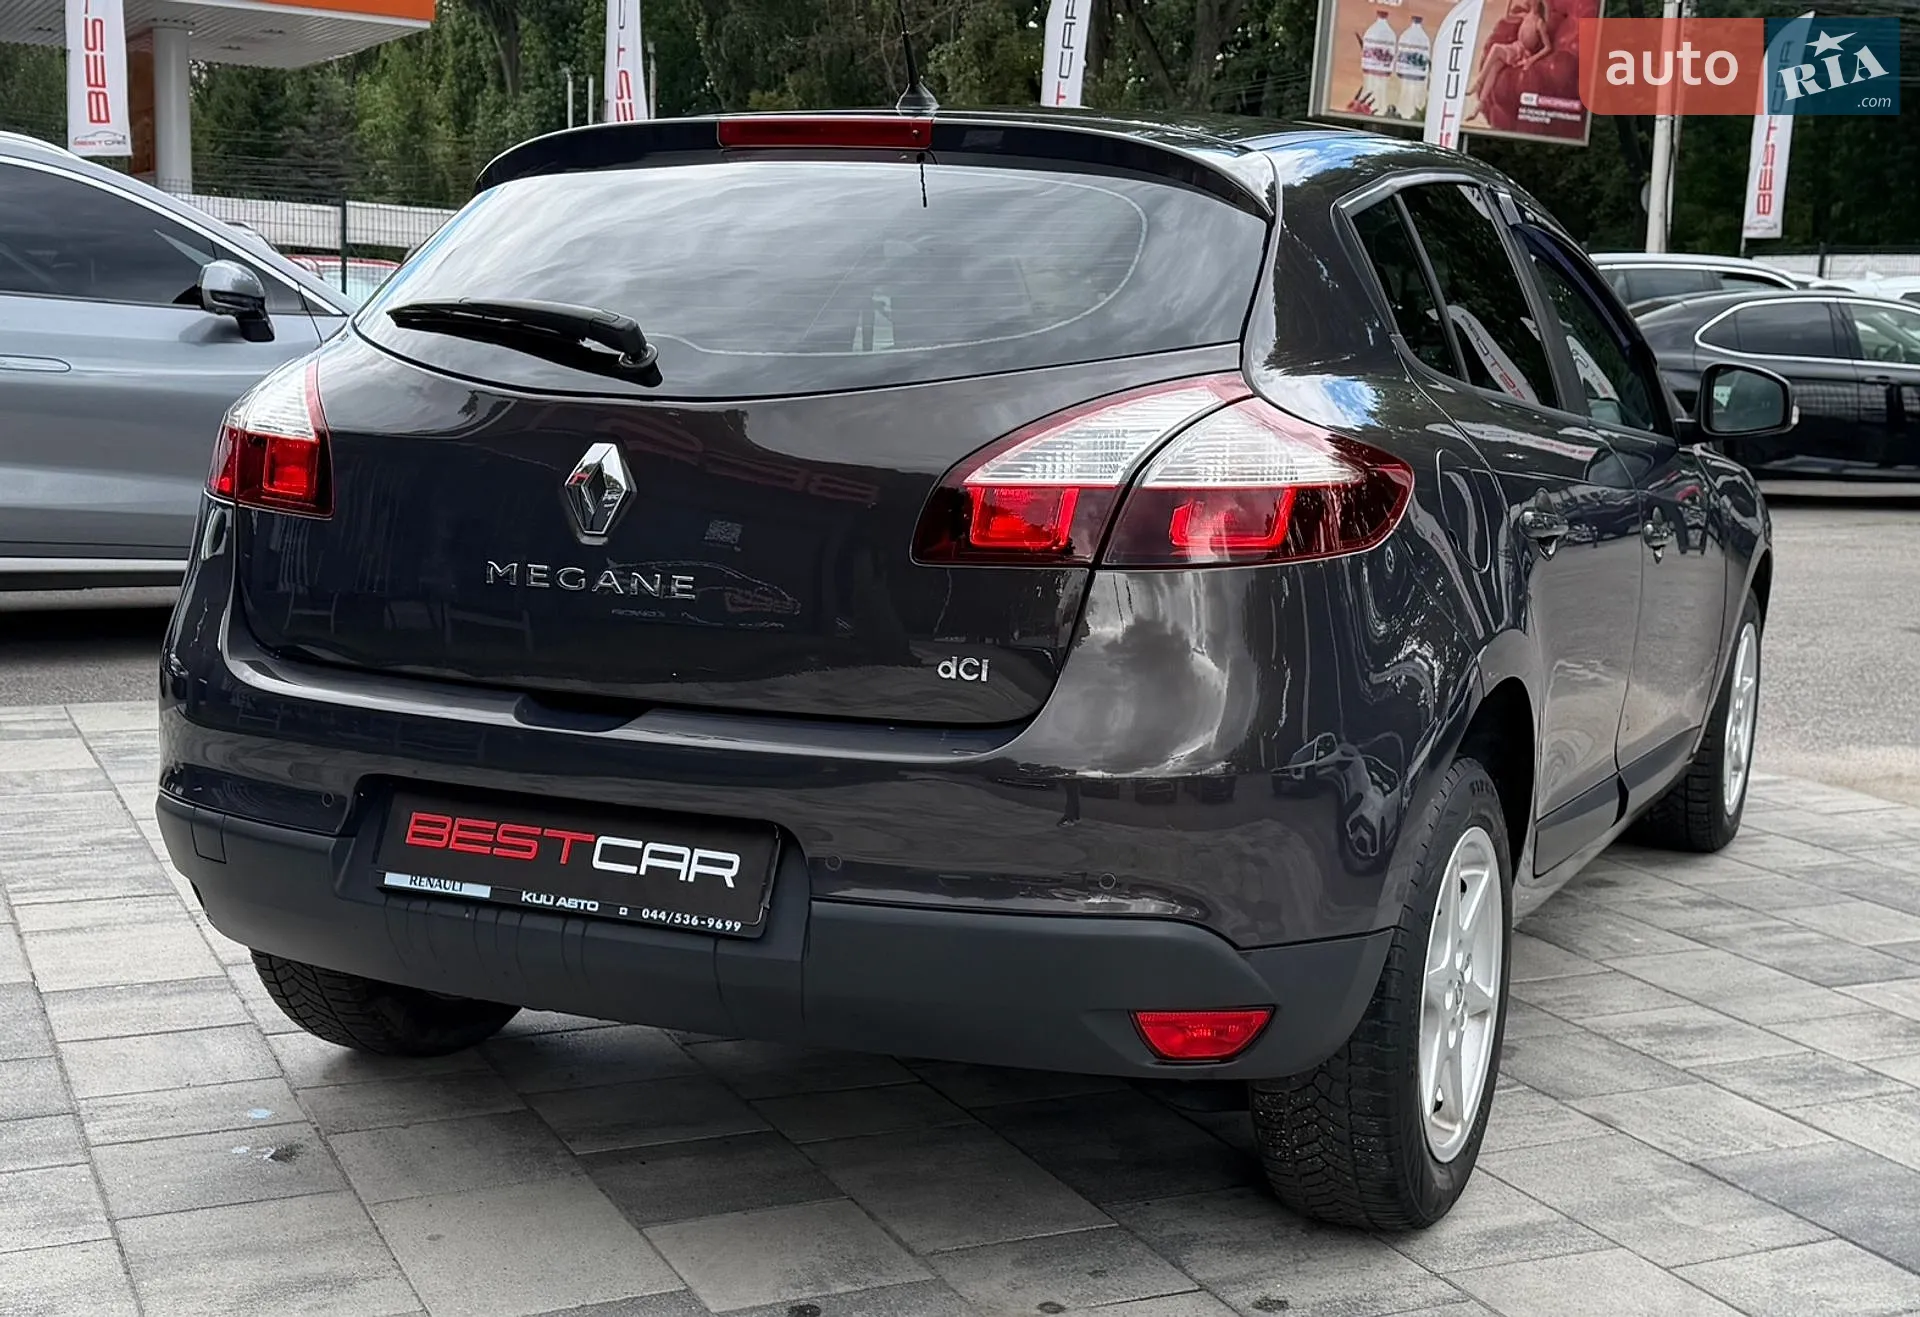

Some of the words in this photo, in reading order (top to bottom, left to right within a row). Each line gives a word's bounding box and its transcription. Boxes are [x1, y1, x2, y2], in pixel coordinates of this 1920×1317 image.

[486, 560, 696, 600] MEGANE
[409, 875, 464, 893] RENAULT
[641, 908, 742, 932] 044/536-9699
